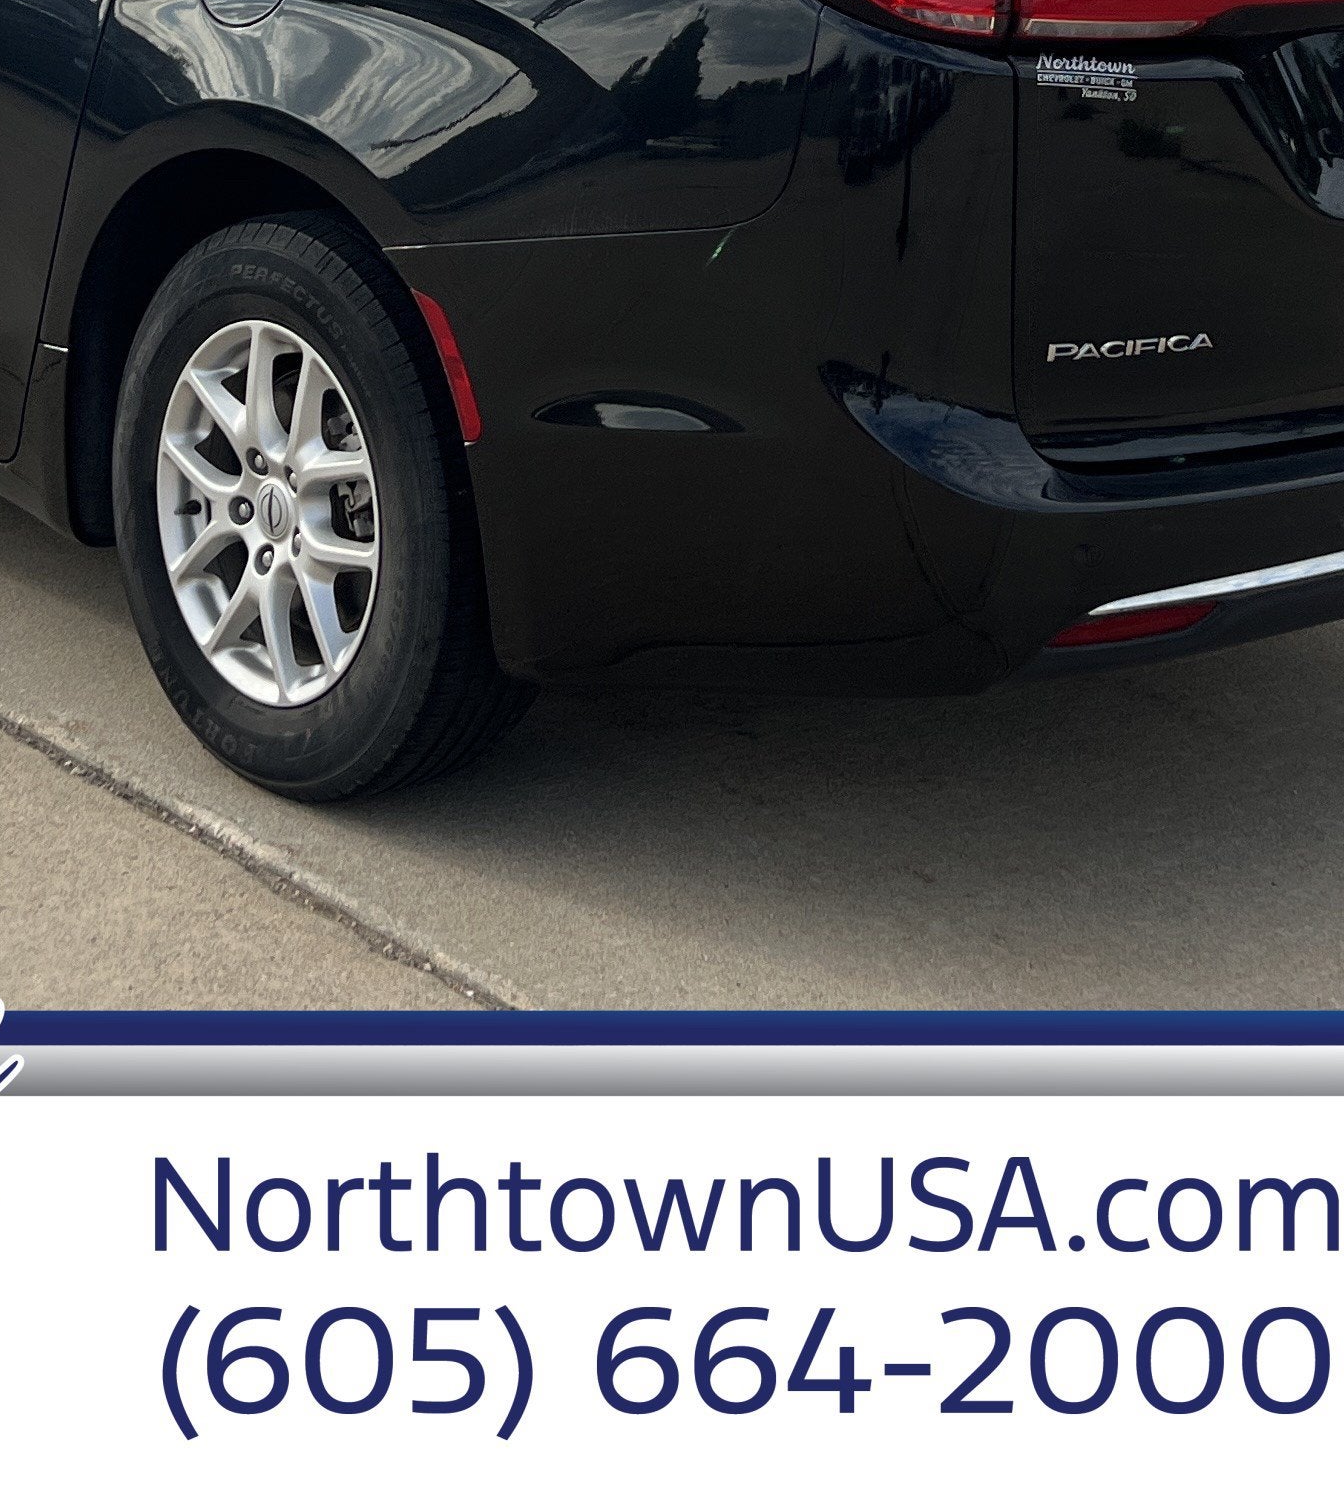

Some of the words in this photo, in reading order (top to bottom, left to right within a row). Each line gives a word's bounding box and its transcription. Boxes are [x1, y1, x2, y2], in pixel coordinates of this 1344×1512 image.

[1036, 52, 1136, 74] Northtown
[1037, 73, 1085, 84] CHEVROLET
[1046, 333, 1213, 363] PACIFICA
